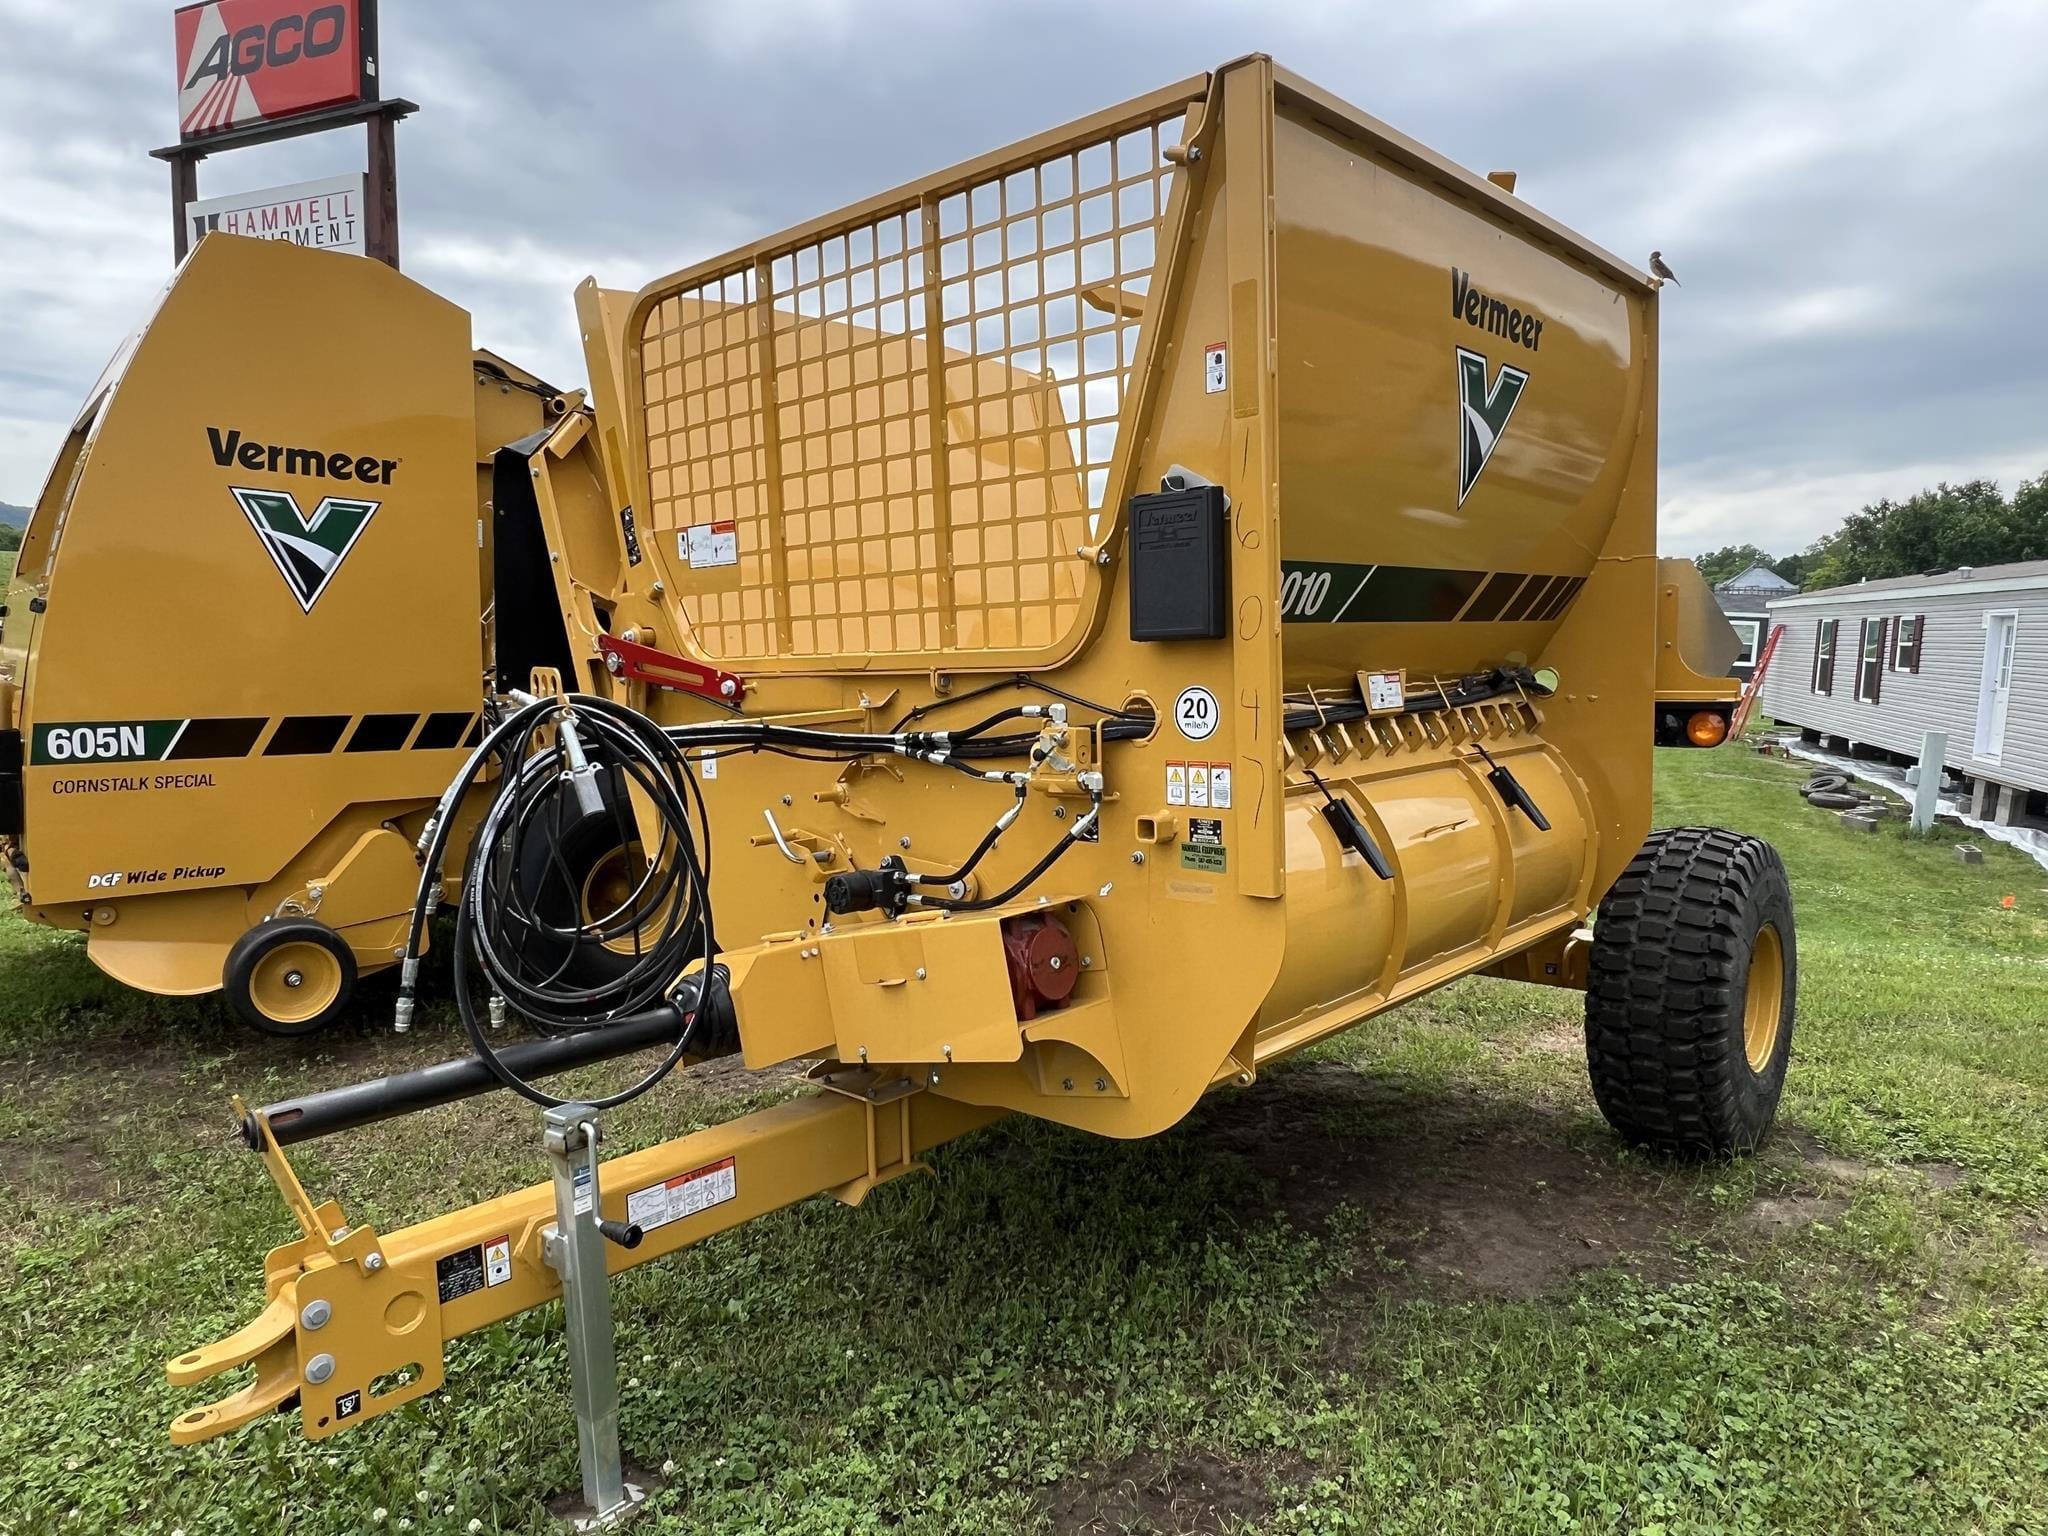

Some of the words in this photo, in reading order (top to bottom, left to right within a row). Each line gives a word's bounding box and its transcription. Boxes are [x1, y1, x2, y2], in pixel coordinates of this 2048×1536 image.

[184, 5, 346, 90] AGCO
[227, 195, 355, 233] HAMMELL
[1452, 266, 1543, 351] Vermeer
[206, 427, 397, 485] Vermeer
[1183, 697, 1208, 719] 20
[1184, 721, 1209, 729] mile/h
[47, 726, 145, 760] 605N
[52, 777, 149, 794] CORNSTALK
[154, 774, 217, 789] SPECIAL
[88, 873, 123, 888] DCF
[127, 870, 167, 884] Wide
[173, 866, 226, 880] Pickup
